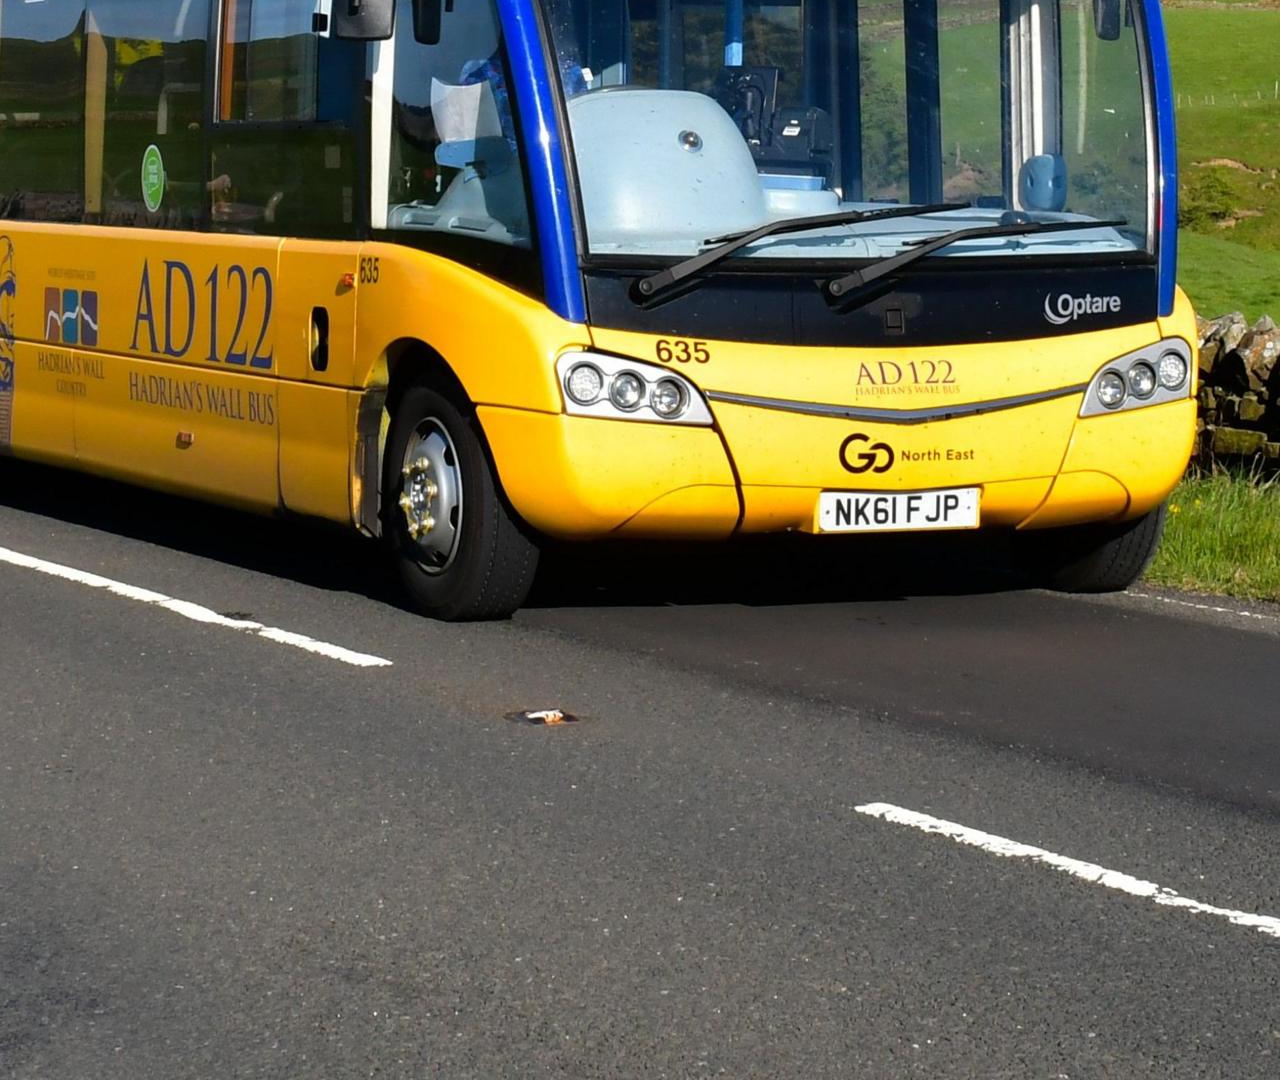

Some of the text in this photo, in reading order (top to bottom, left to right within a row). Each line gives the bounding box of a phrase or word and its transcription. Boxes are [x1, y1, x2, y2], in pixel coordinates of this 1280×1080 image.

[360, 256, 380, 284] 635
[1057, 293, 1122, 320] Optare
[655, 339, 710, 364] 635
[83, 358, 105, 379] WALL
[129, 372, 275, 426] HADRIAN'S WALL BUS
[855, 385, 960, 396] HADRIAN'S WALL BUS
[901, 449, 974, 462] North East
[835, 494, 959, 526] NK61 FJP
